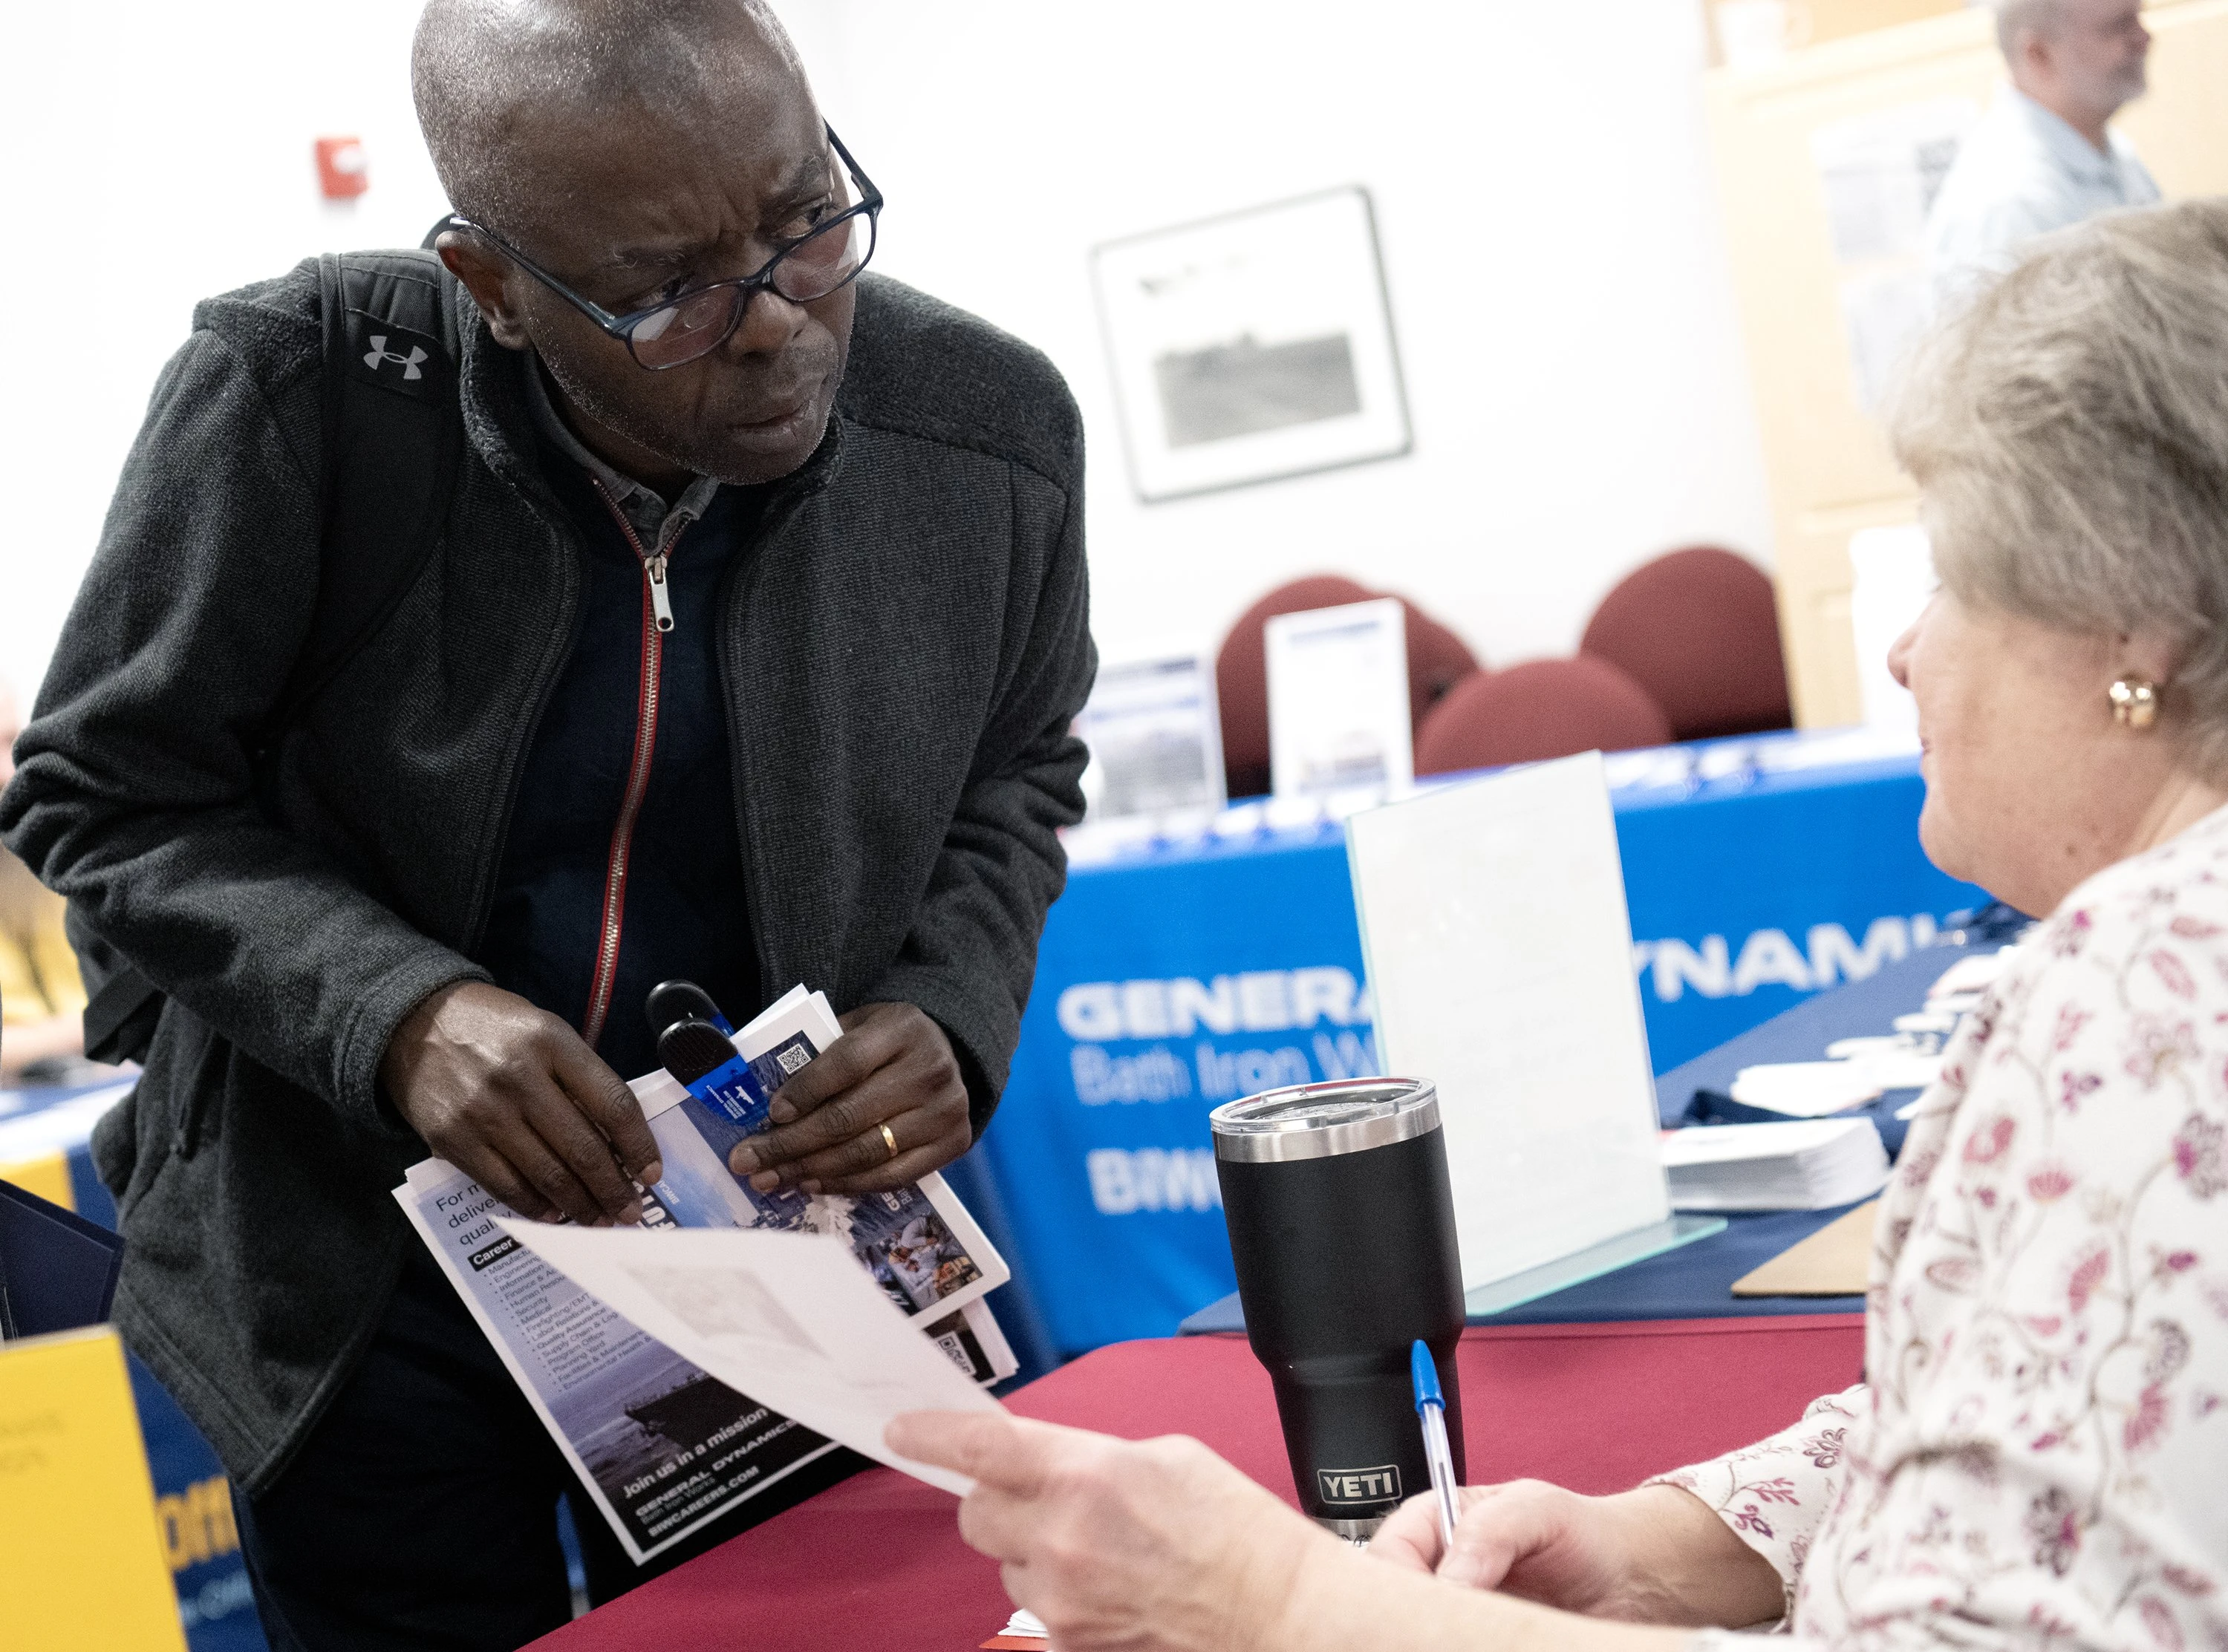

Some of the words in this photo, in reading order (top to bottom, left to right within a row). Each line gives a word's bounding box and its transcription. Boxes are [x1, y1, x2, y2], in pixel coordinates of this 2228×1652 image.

[1057, 965, 1371, 1041] GENER
[436, 1192, 463, 1211] For
[896, 1188, 913, 1206] Bat
[472, 1238, 513, 1265] Career
[489, 1248, 530, 1273] Manufactu
[500, 1264, 544, 1292] Information
[505, 1279, 535, 1299] Finance
[510, 1288, 539, 1307] Human
[540, 1274, 564, 1290] Resou
[515, 1295, 547, 1316] Security
[521, 1304, 551, 1325] Medical
[532, 1325, 556, 1341] Labor
[556, 1305, 590, 1327] Relations
[537, 1331, 565, 1350] Quality
[565, 1307, 605, 1333] Assurance
[542, 1339, 570, 1358] Supply
[570, 1325, 593, 1341] Chain
[602, 1311, 618, 1324] Log
[548, 1344, 582, 1366] Program
[582, 1330, 605, 1346] Office
[553, 1351, 587, 1374] Planning
[587, 1340, 605, 1354] Yard
[623, 1473, 655, 1498] Join
[655, 1460, 677, 1478] us
[675, 1449, 694, 1466] in
[694, 1443, 706, 1455] a
[707, 1407, 768, 1447] mission
[635, 1469, 710, 1517] GENERAL
[711, 1417, 797, 1471] DYNAMICS
[646, 1465, 760, 1537] BIWCAREERS.COM
[1323, 1472, 1393, 1498] YETI
